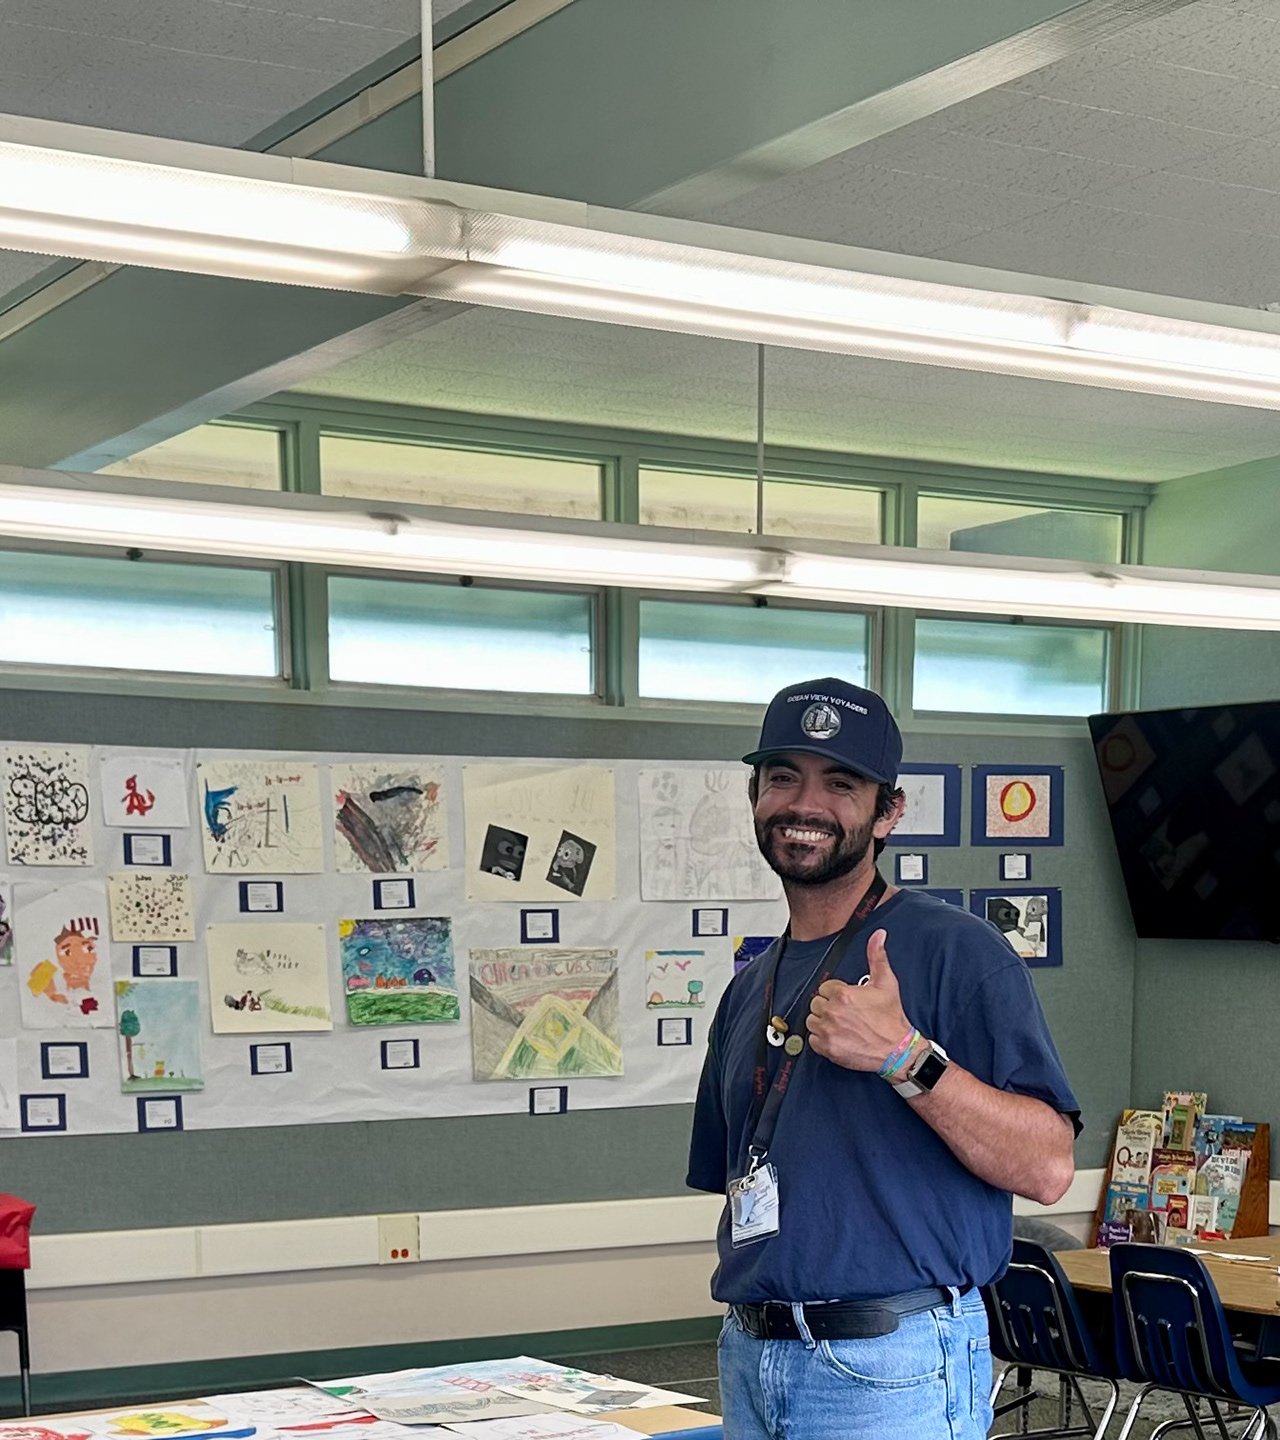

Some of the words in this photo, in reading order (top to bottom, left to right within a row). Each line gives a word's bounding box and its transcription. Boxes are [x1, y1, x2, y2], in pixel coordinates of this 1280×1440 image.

[786, 693, 811, 703] OCEAN
[810, 693, 829, 702] VIEW
[830, 695, 869, 715] VOYAGERS
